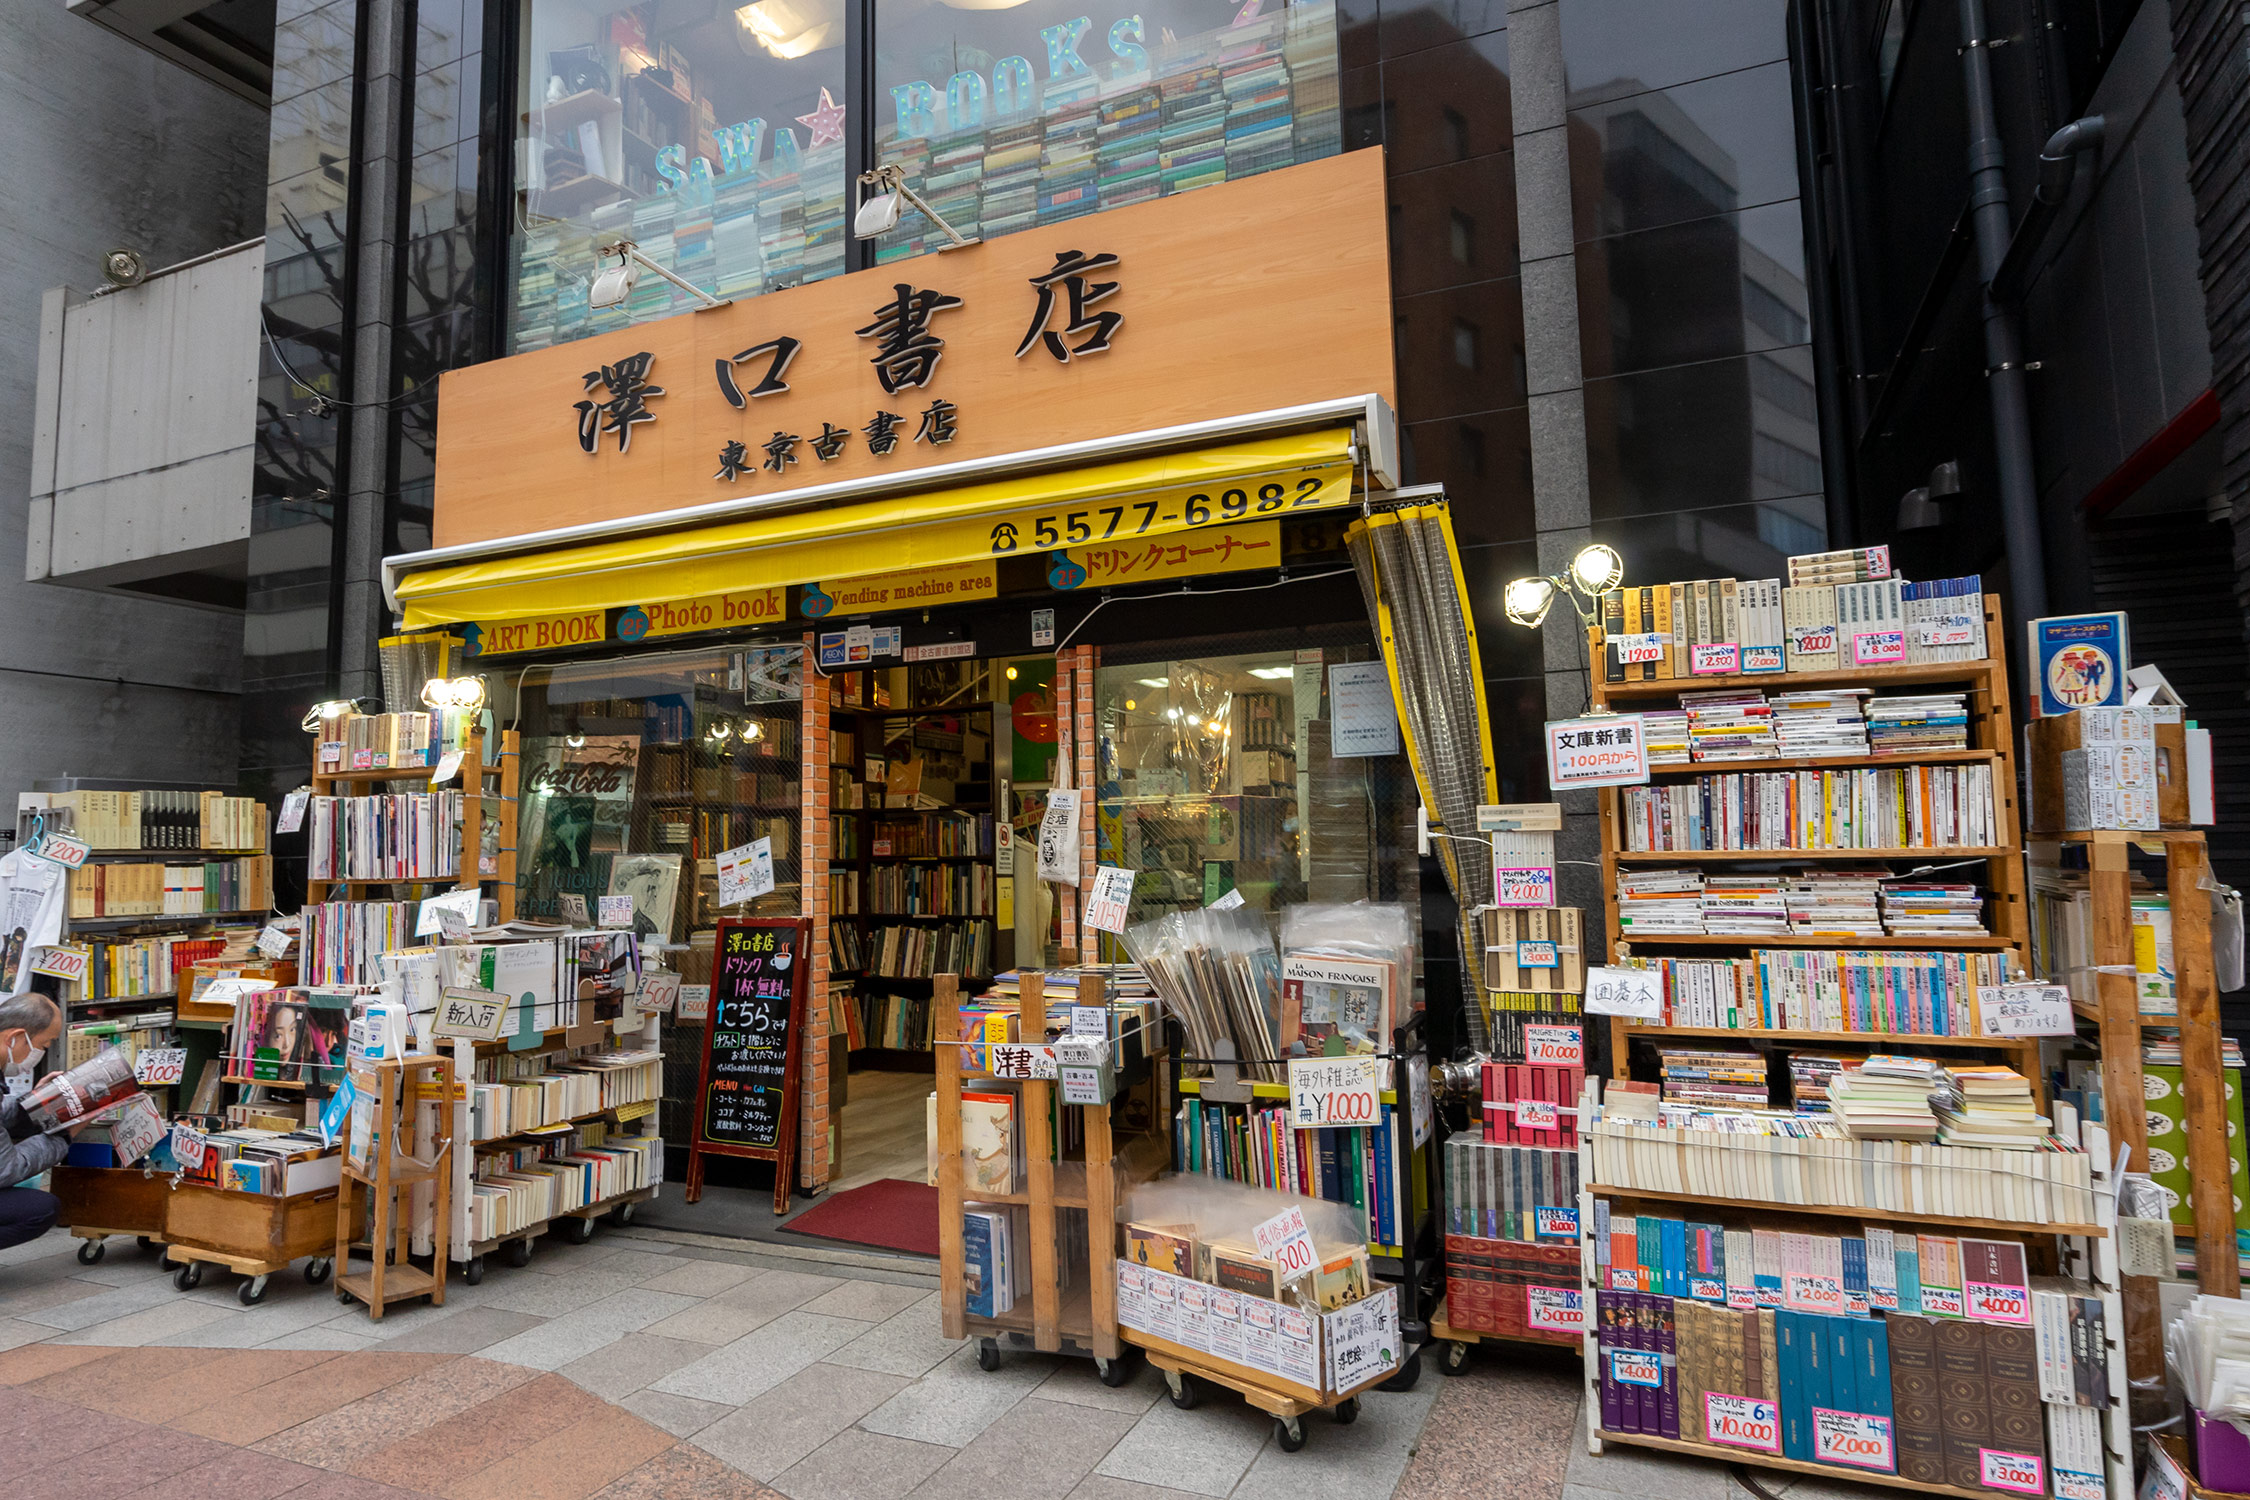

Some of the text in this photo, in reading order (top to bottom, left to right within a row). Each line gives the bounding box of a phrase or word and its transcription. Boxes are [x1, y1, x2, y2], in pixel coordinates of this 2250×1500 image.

[889, 14, 1150, 141] BOOKS
[573, 249, 1128, 456] 澤口書店
[713, 399, 959, 483] 東京古書店
[1034, 478, 1324, 548] 5577-6982
[1086, 535, 1271, 579] ドリンクコーナー
[1057, 569, 1077, 586] 2F
[831, 576, 992, 606] Vending machine area
[647, 589, 781, 631] Photo book
[809, 599, 827, 614] 2F
[485, 614, 602, 654] ART BOOK
[623, 618, 644, 636] 2F
[1557, 728, 1633, 750] 文庫新書
[1570, 751, 1637, 768] 100円から
[43, 837, 85, 864] ¥200
[600, 909, 633, 922] ¥900
[726, 932, 775, 953] 澤口書店
[38, 948, 83, 975] ¥200
[725, 956, 763, 974] ドリンク
[1287, 968, 1377, 984] MAISON FRANÇAISE
[645, 980, 674, 1006] 500
[1594, 978, 1654, 1004] 囲碁本
[446, 1002, 498, 1028] 新入荷
[995, 1047, 1034, 1079] 洋書
[713, 1079, 738, 1091] MENU
[1293, 1066, 1363, 1089] 海外雑誌
[1257, 1210, 1305, 1248] 風俗画報
[1709, 1394, 1746, 1409] REVUE
